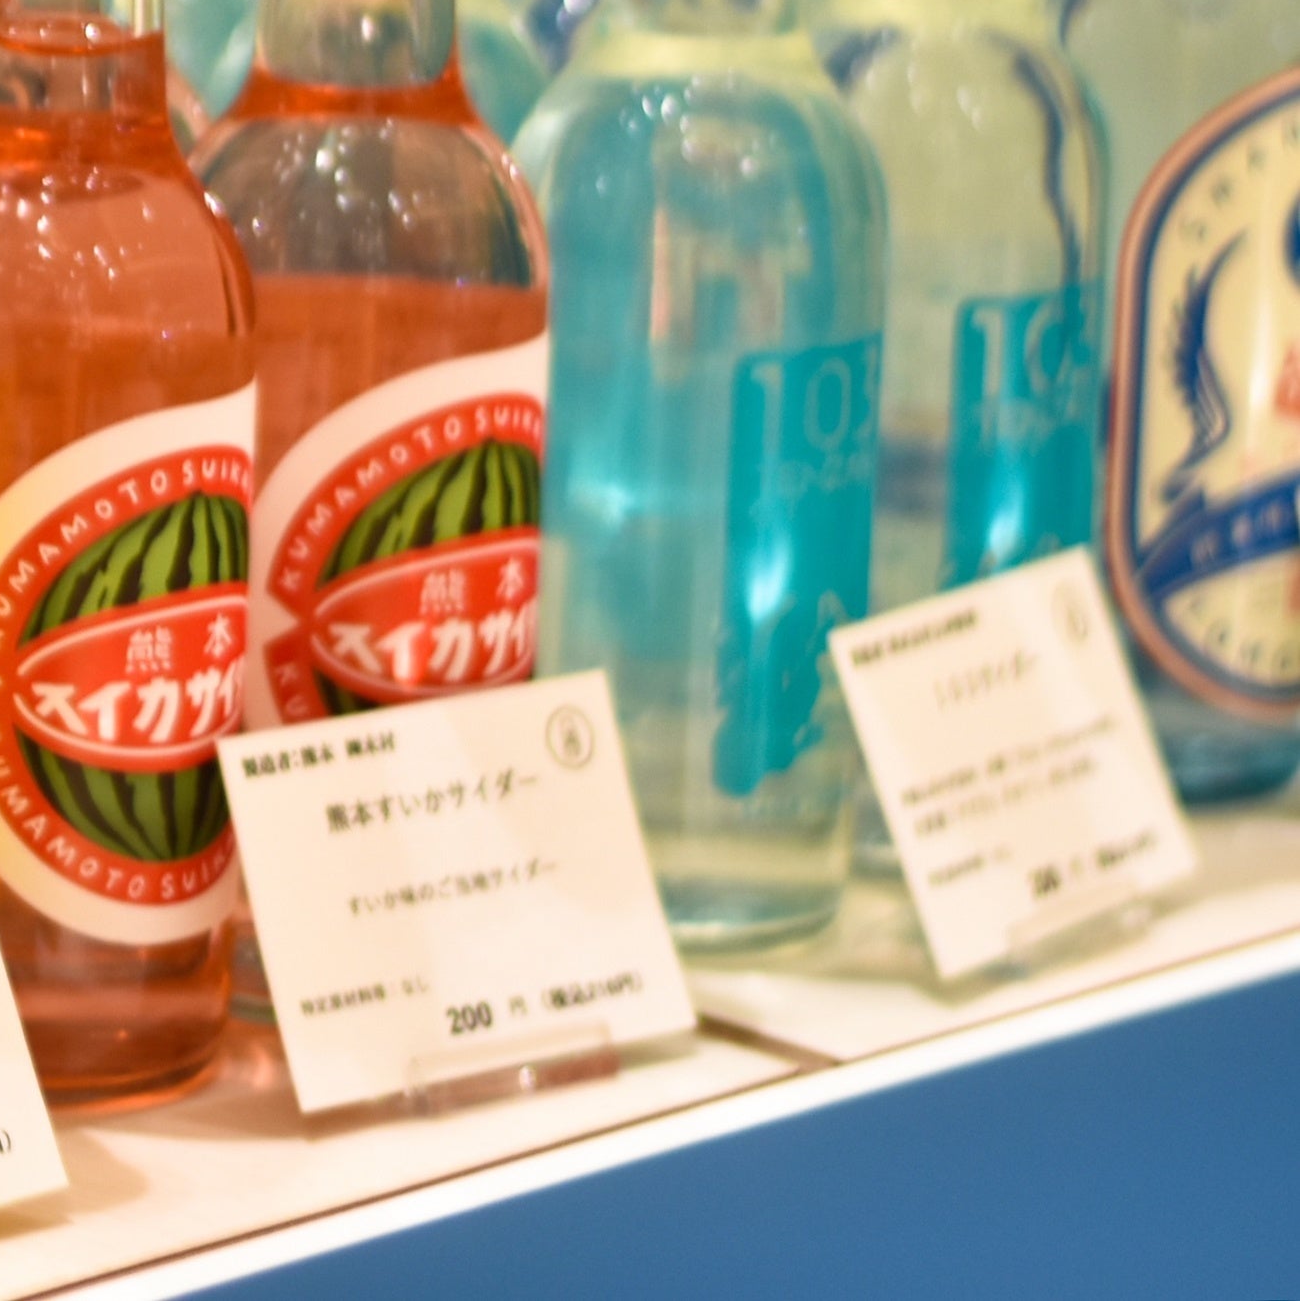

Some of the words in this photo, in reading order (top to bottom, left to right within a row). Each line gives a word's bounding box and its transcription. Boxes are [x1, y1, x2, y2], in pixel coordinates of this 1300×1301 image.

[279, 416, 464, 593] KUMAMOTO
[419, 558, 527, 616] 熊本
[125, 611, 240, 672] 熊本
[327, 606, 534, 688] スイカサイ
[31, 656, 243, 744] スイカサイ
[325, 767, 542, 834] 熊本すいかサイダー
[445, 1001, 493, 1035] 200
